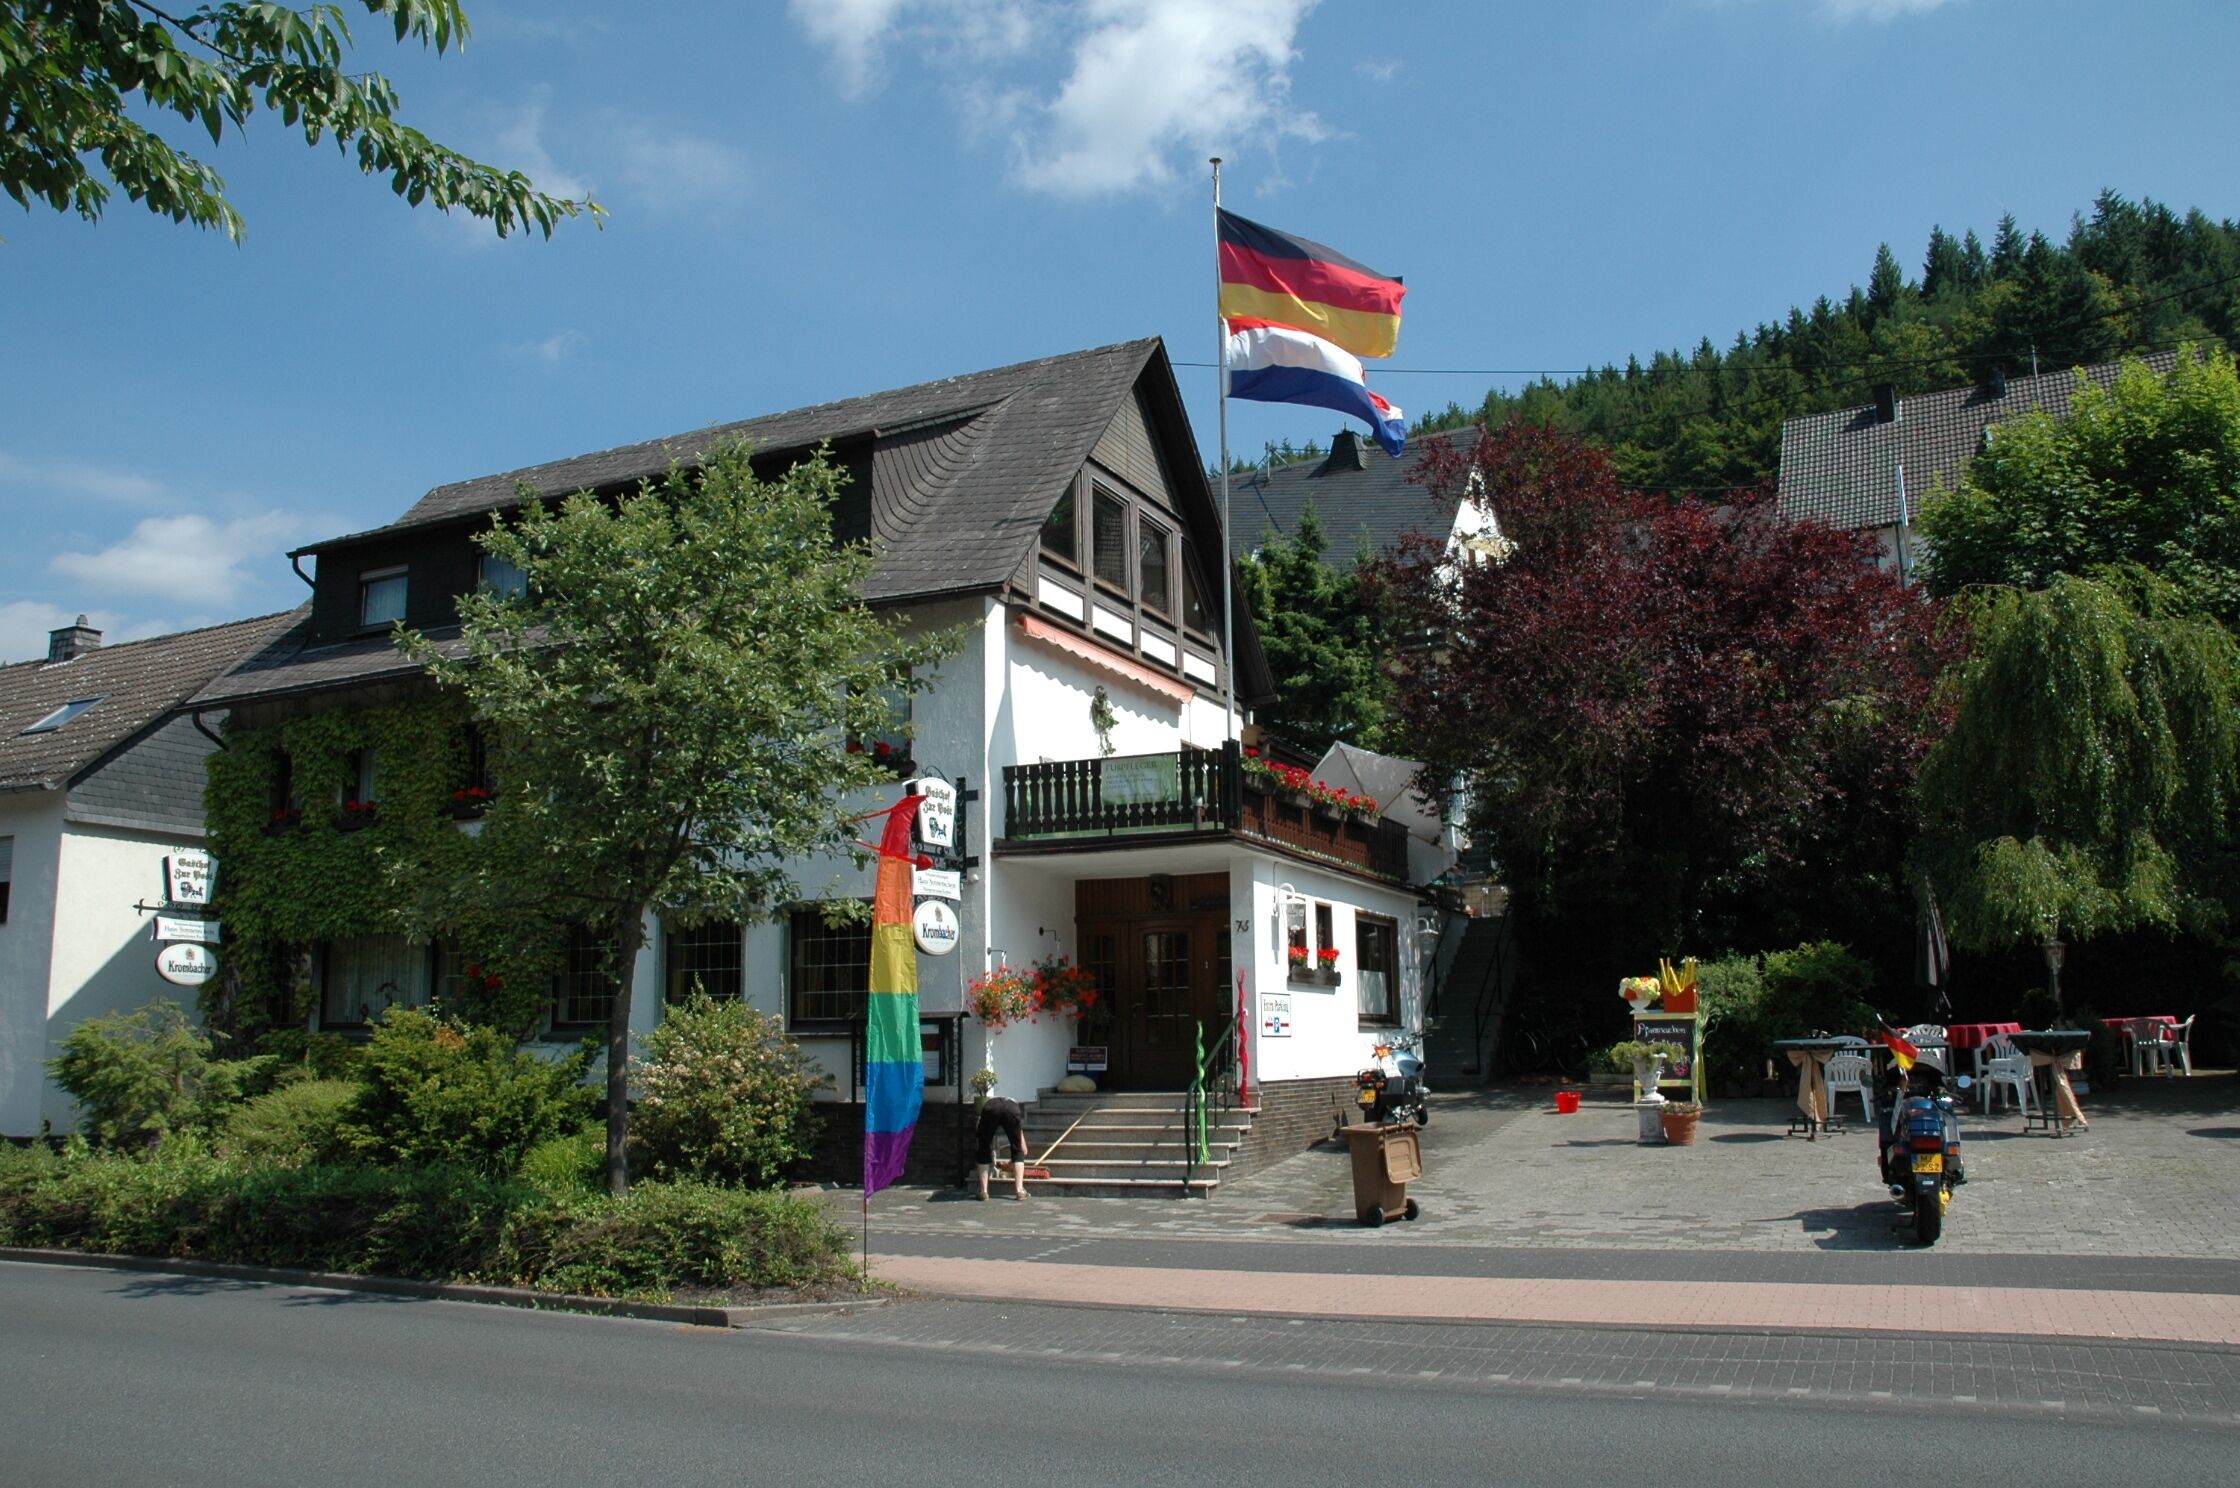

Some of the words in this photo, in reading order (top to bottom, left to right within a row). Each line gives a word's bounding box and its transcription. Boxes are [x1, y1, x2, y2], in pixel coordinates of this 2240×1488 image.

[922, 923, 956, 941] Krombacher
[1235, 919, 1249, 933] 75
[168, 960, 212, 975] Krombacher
